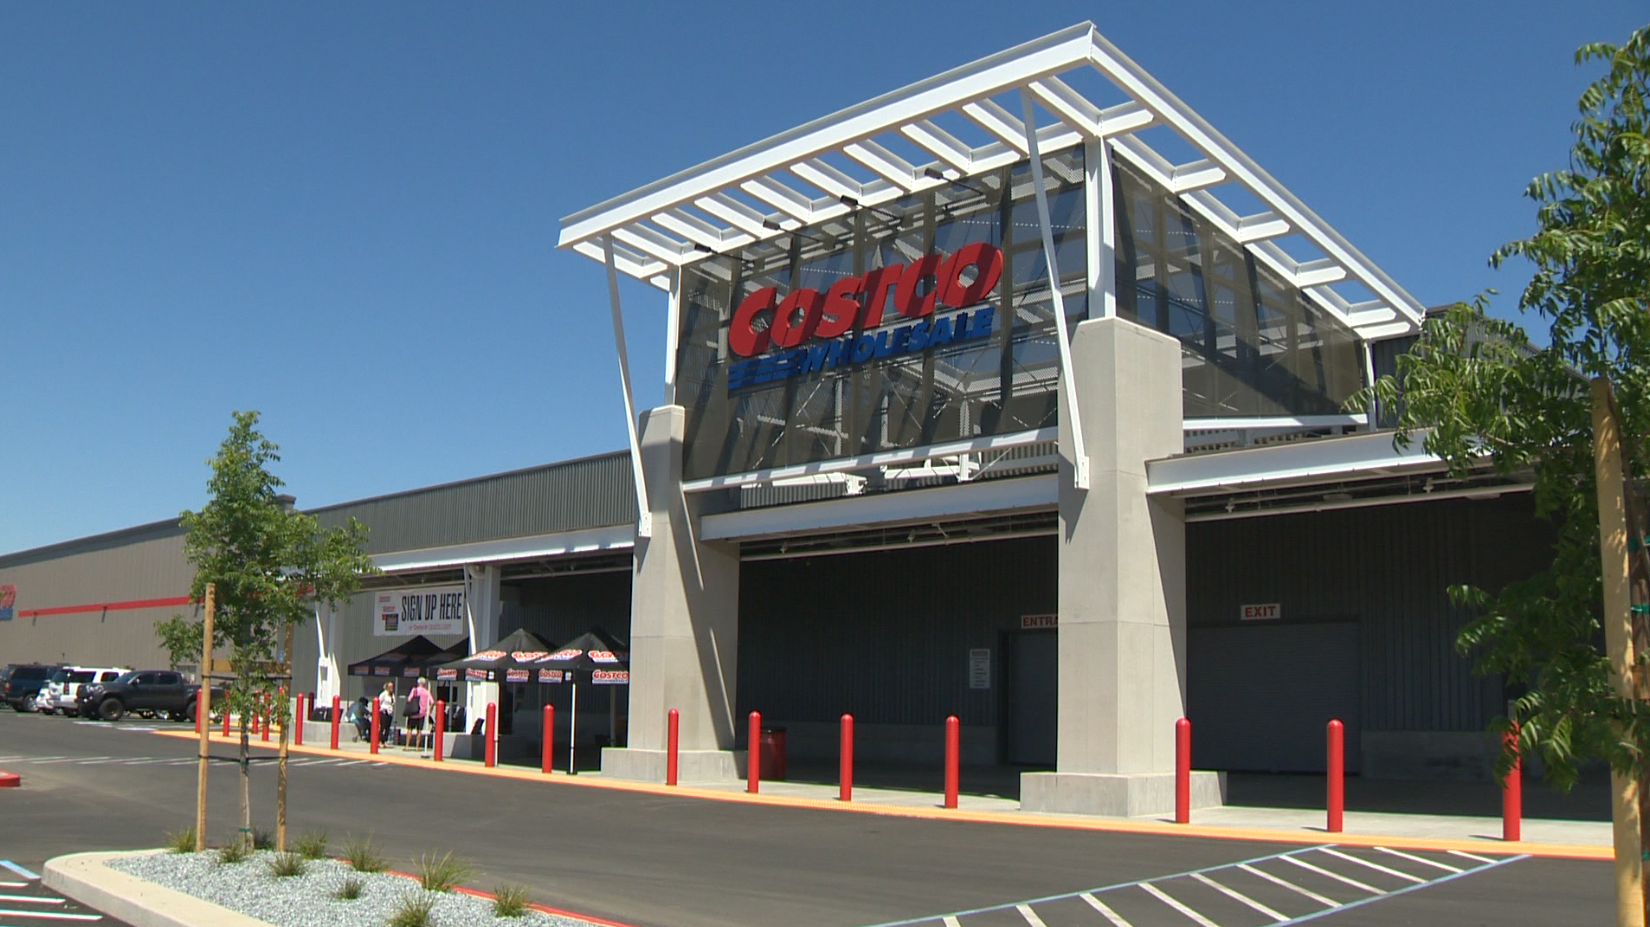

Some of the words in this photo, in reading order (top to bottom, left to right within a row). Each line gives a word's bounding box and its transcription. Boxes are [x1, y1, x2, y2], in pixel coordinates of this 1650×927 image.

[729, 242, 1003, 356] COSTCO
[798, 307, 995, 374] WHOLESALE
[401, 595, 422, 621] SIGN
[425, 594, 437, 620] UP
[439, 593, 462, 619] HERE
[1245, 605, 1276, 617] EXIT
